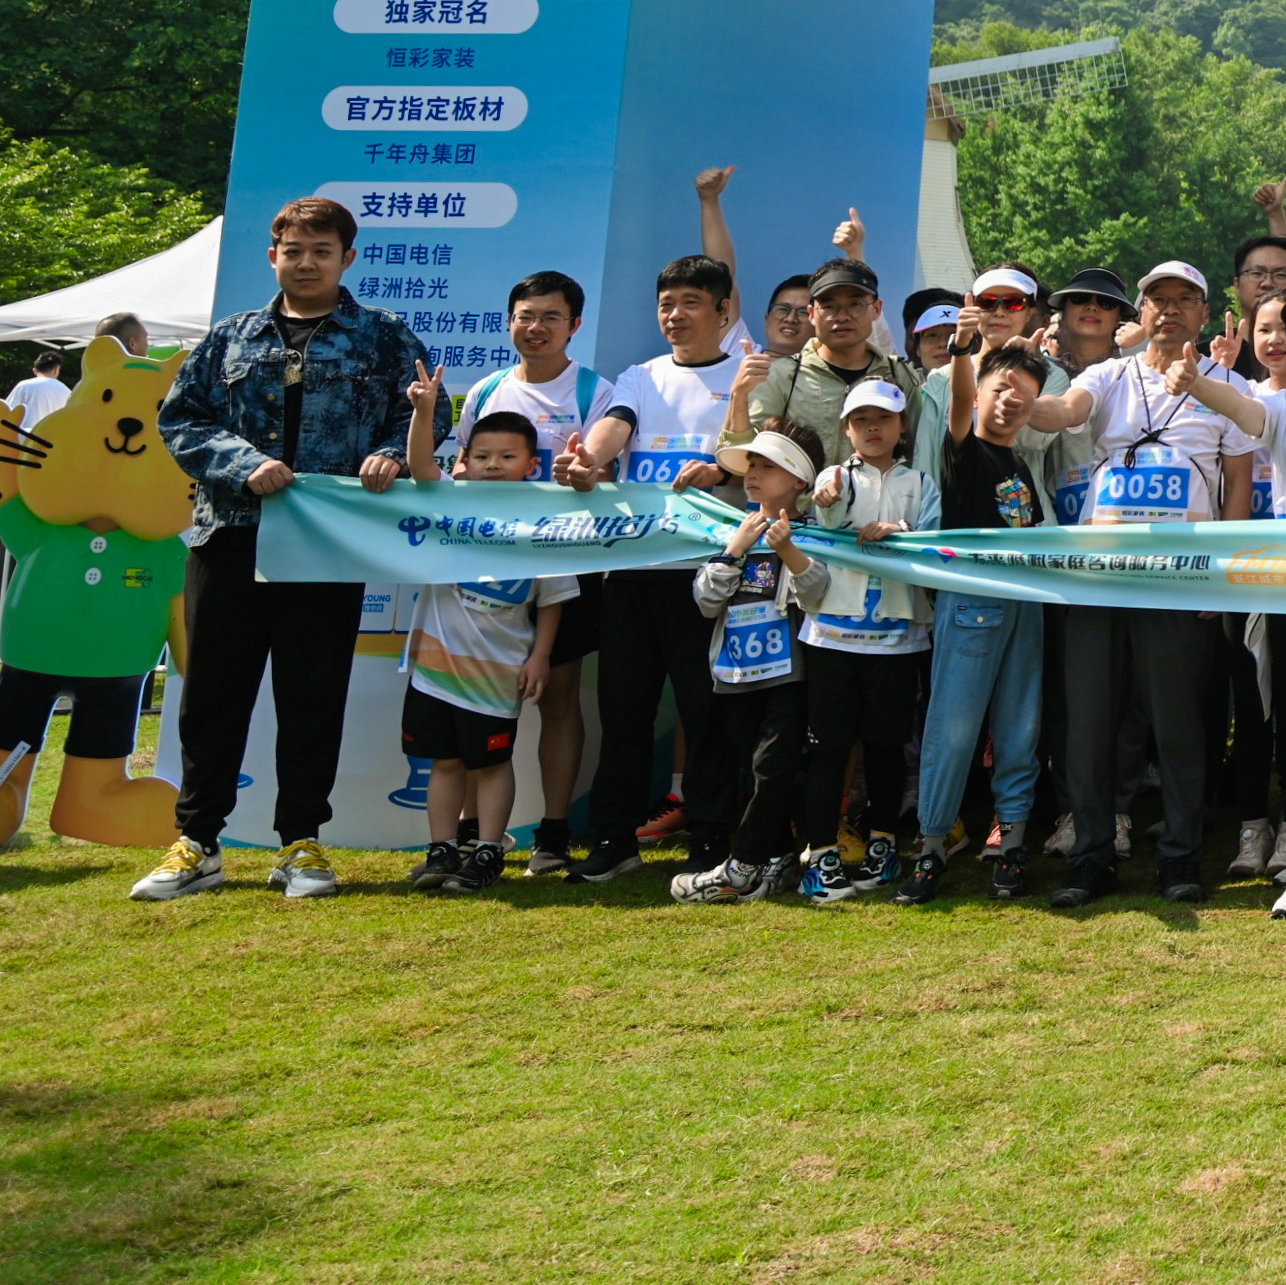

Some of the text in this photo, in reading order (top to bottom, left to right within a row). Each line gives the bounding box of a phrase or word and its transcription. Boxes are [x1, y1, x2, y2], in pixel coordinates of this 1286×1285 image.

[384, 0, 489, 25] 独家冠名
[385, 47, 476, 69] 恒彩家装
[345, 95, 505, 122] 官方指定板材
[363, 143, 476, 165] 千年舟集团
[359, 191, 467, 219] 支持单位
[362, 243, 453, 266] 中国电信
[358, 276, 449, 300] 绿洲拾光
[1108, 474, 1182, 500] 0058
[435, 516, 523, 539] 中国电信
